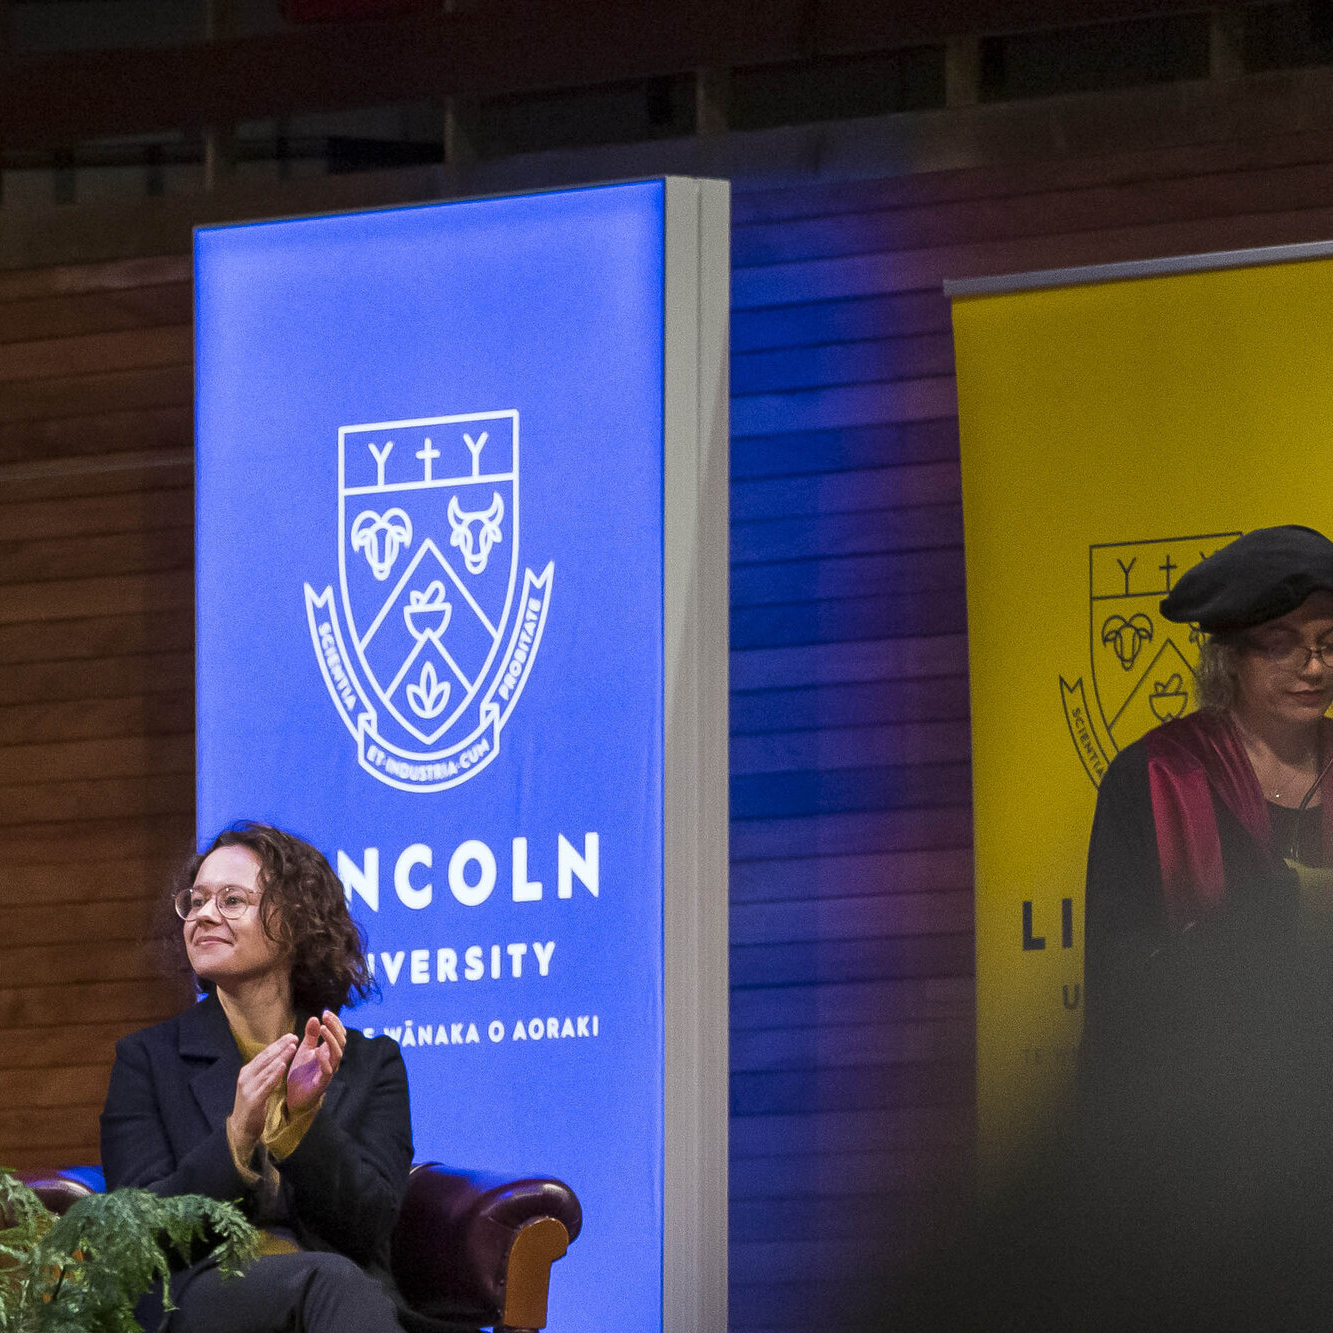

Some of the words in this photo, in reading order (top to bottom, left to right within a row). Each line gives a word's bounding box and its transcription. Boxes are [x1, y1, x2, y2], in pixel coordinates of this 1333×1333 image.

[337, 832, 599, 912] NCOLN
[367, 941, 556, 985] IVERSITY
[488, 1020, 505, 1043] O
[512, 1015, 599, 1041] AORAKI
